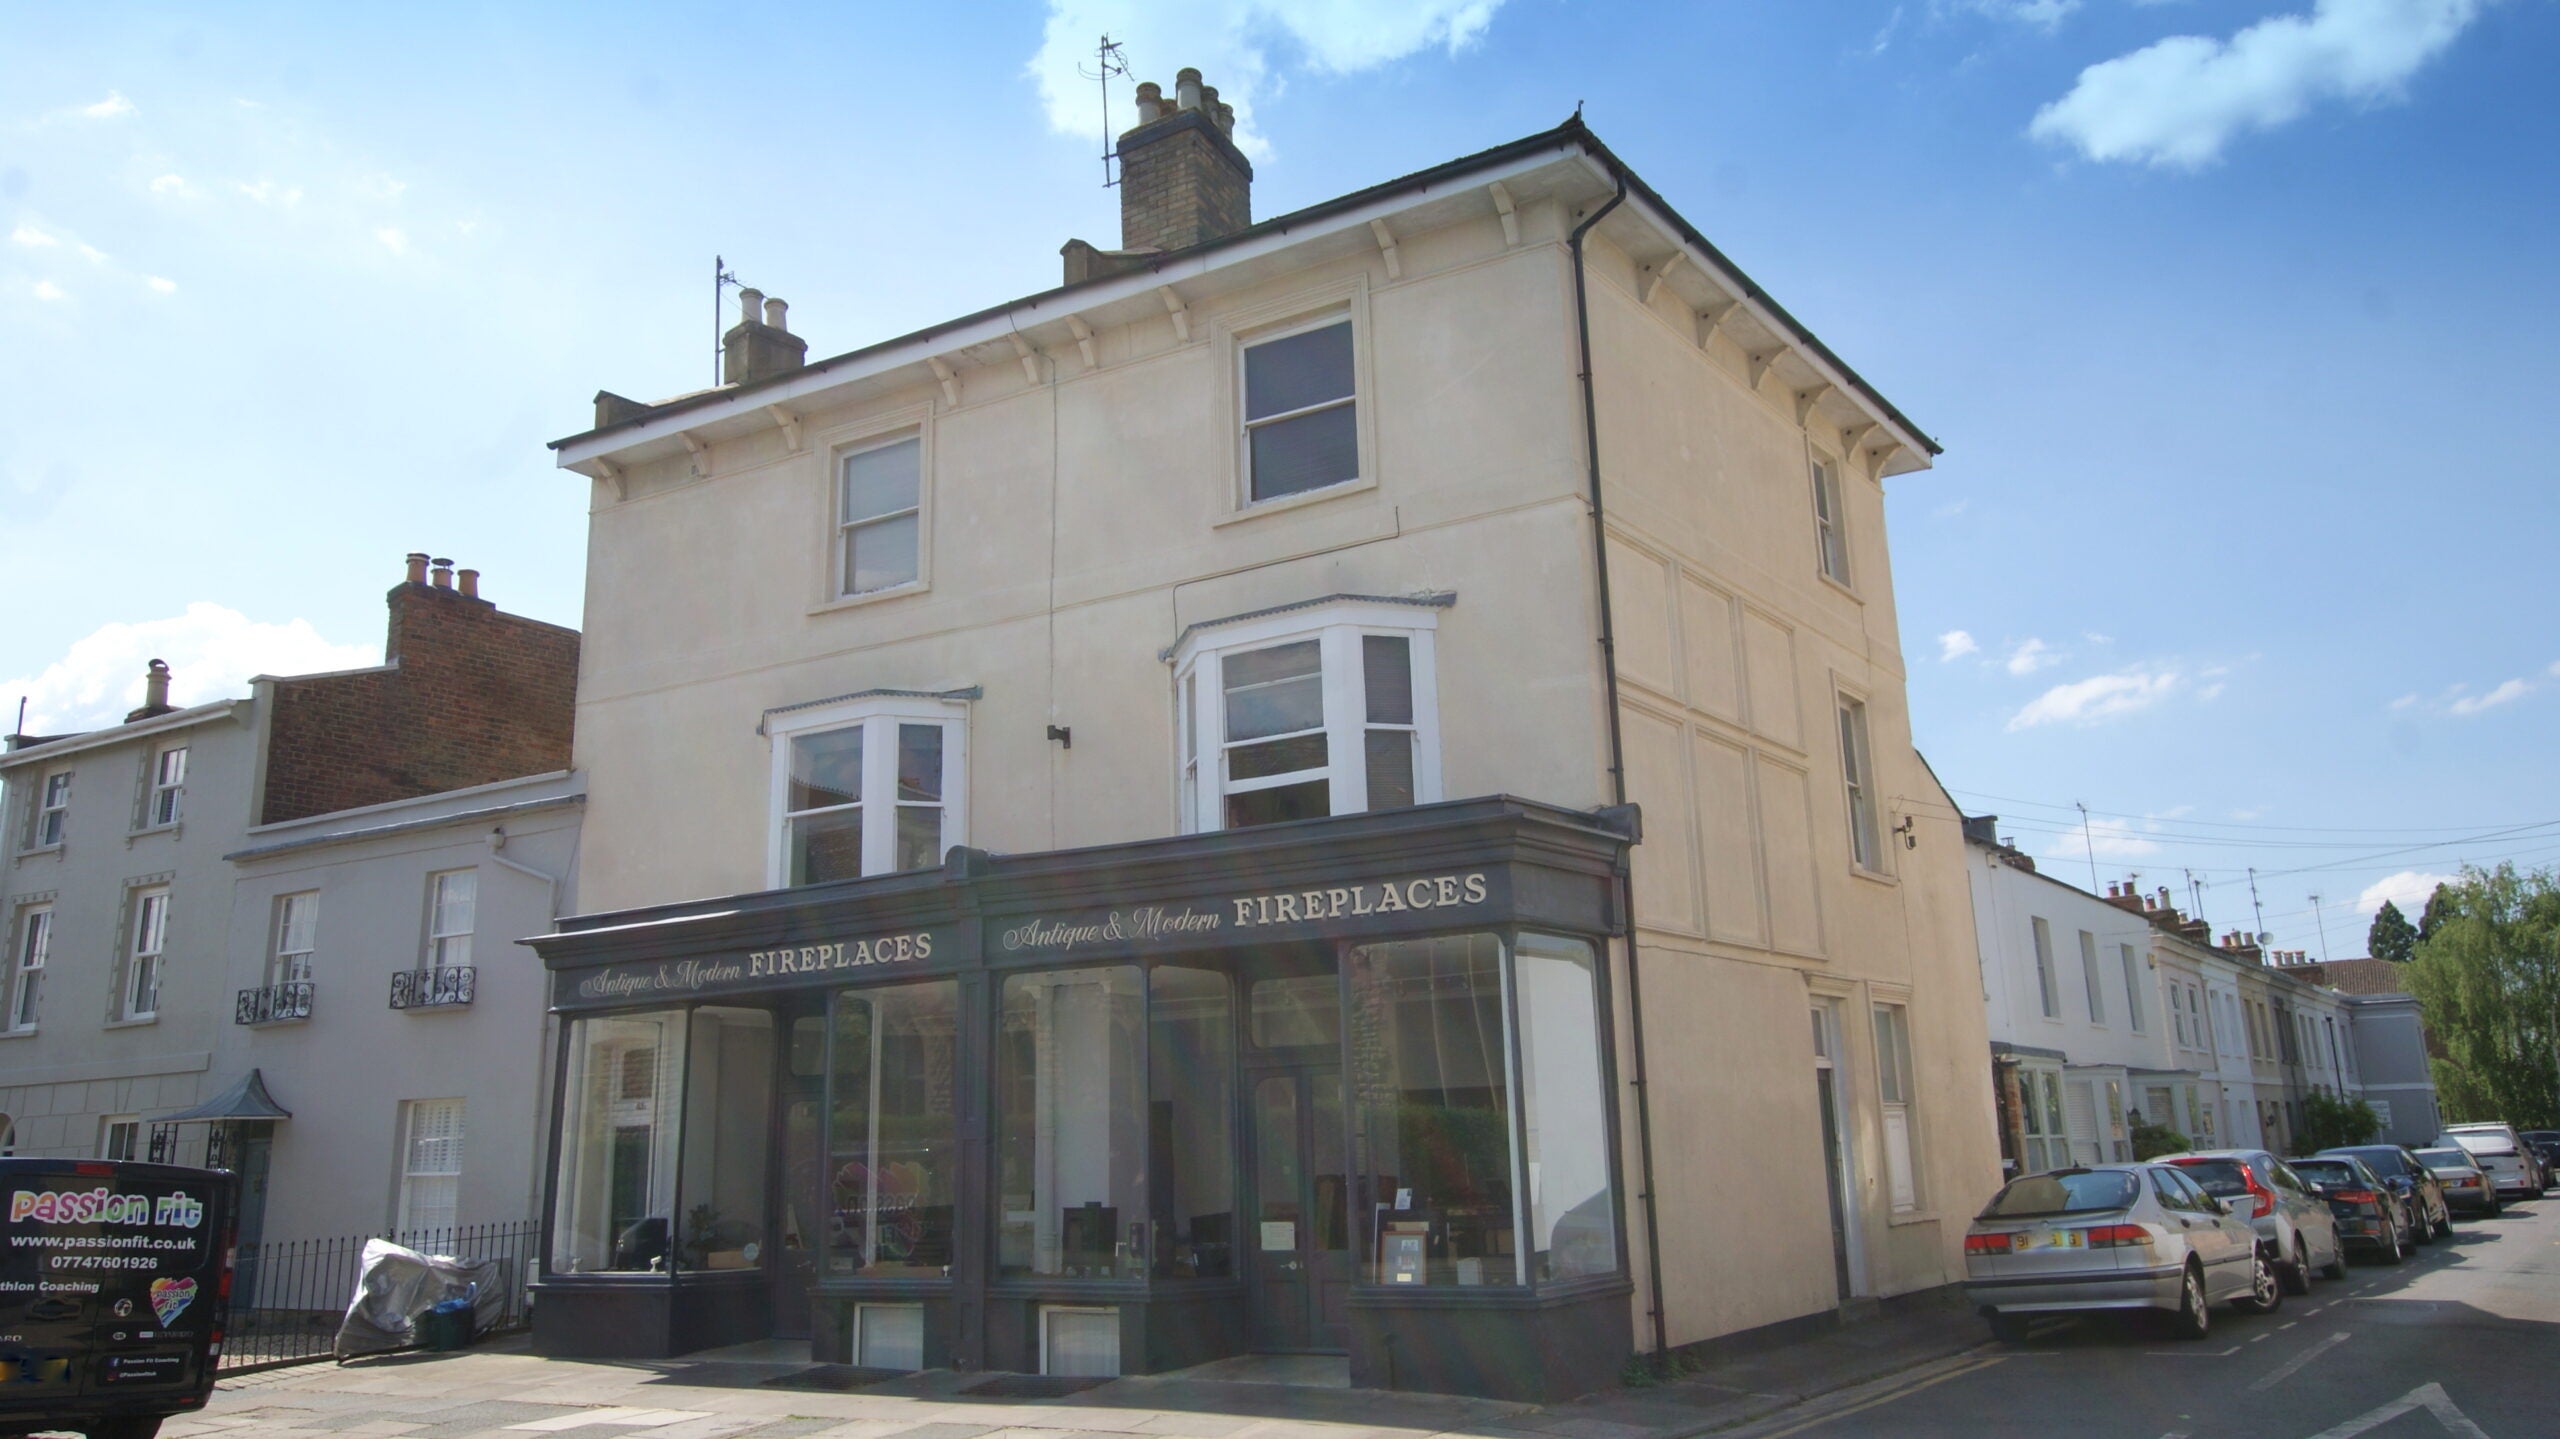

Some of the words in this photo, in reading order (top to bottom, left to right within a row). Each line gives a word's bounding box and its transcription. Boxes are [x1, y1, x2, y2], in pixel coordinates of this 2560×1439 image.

[1002, 918, 1099, 950] Antique
[1103, 911, 1124, 941] &
[1129, 907, 1221, 941] Modern
[1233, 873, 1488, 928] FIREPLACES
[579, 967, 651, 998] Antique
[653, 963, 671, 989] &
[675, 959, 742, 992] Modern
[748, 933, 932, 977] FIREPLACES
[11, 1235, 196, 1250] www.passionfit.co.uk
[51, 1256, 158, 1269] 07747601926
[39, 1281, 100, 1294] Coaching
